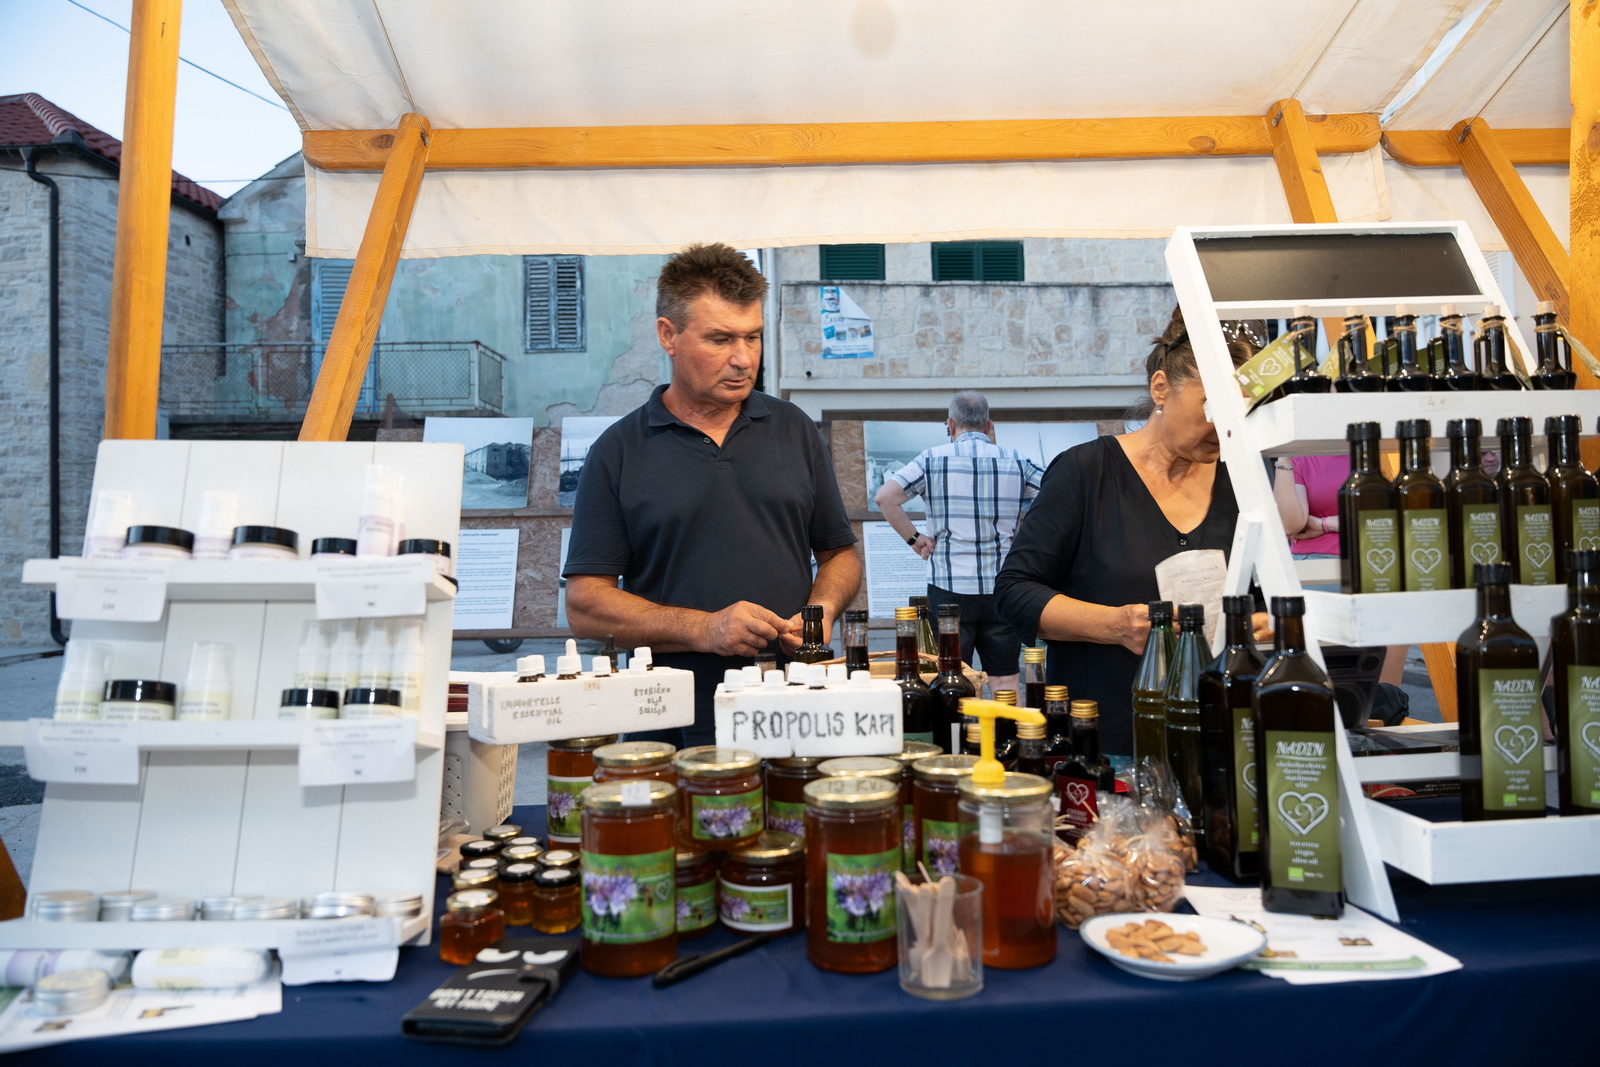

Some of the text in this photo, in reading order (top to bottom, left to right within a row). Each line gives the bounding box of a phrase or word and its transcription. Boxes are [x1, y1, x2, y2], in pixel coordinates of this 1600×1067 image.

[1493, 679, 1536, 693] NADIN
[500, 696, 561, 711] IMMORTELLE
[512, 708, 563, 720] ESSENTIAL
[546, 717, 562, 726] OIL
[732, 710, 896, 742] PROPOLIS KAPI
[1275, 741, 1326, 757] NADIN
